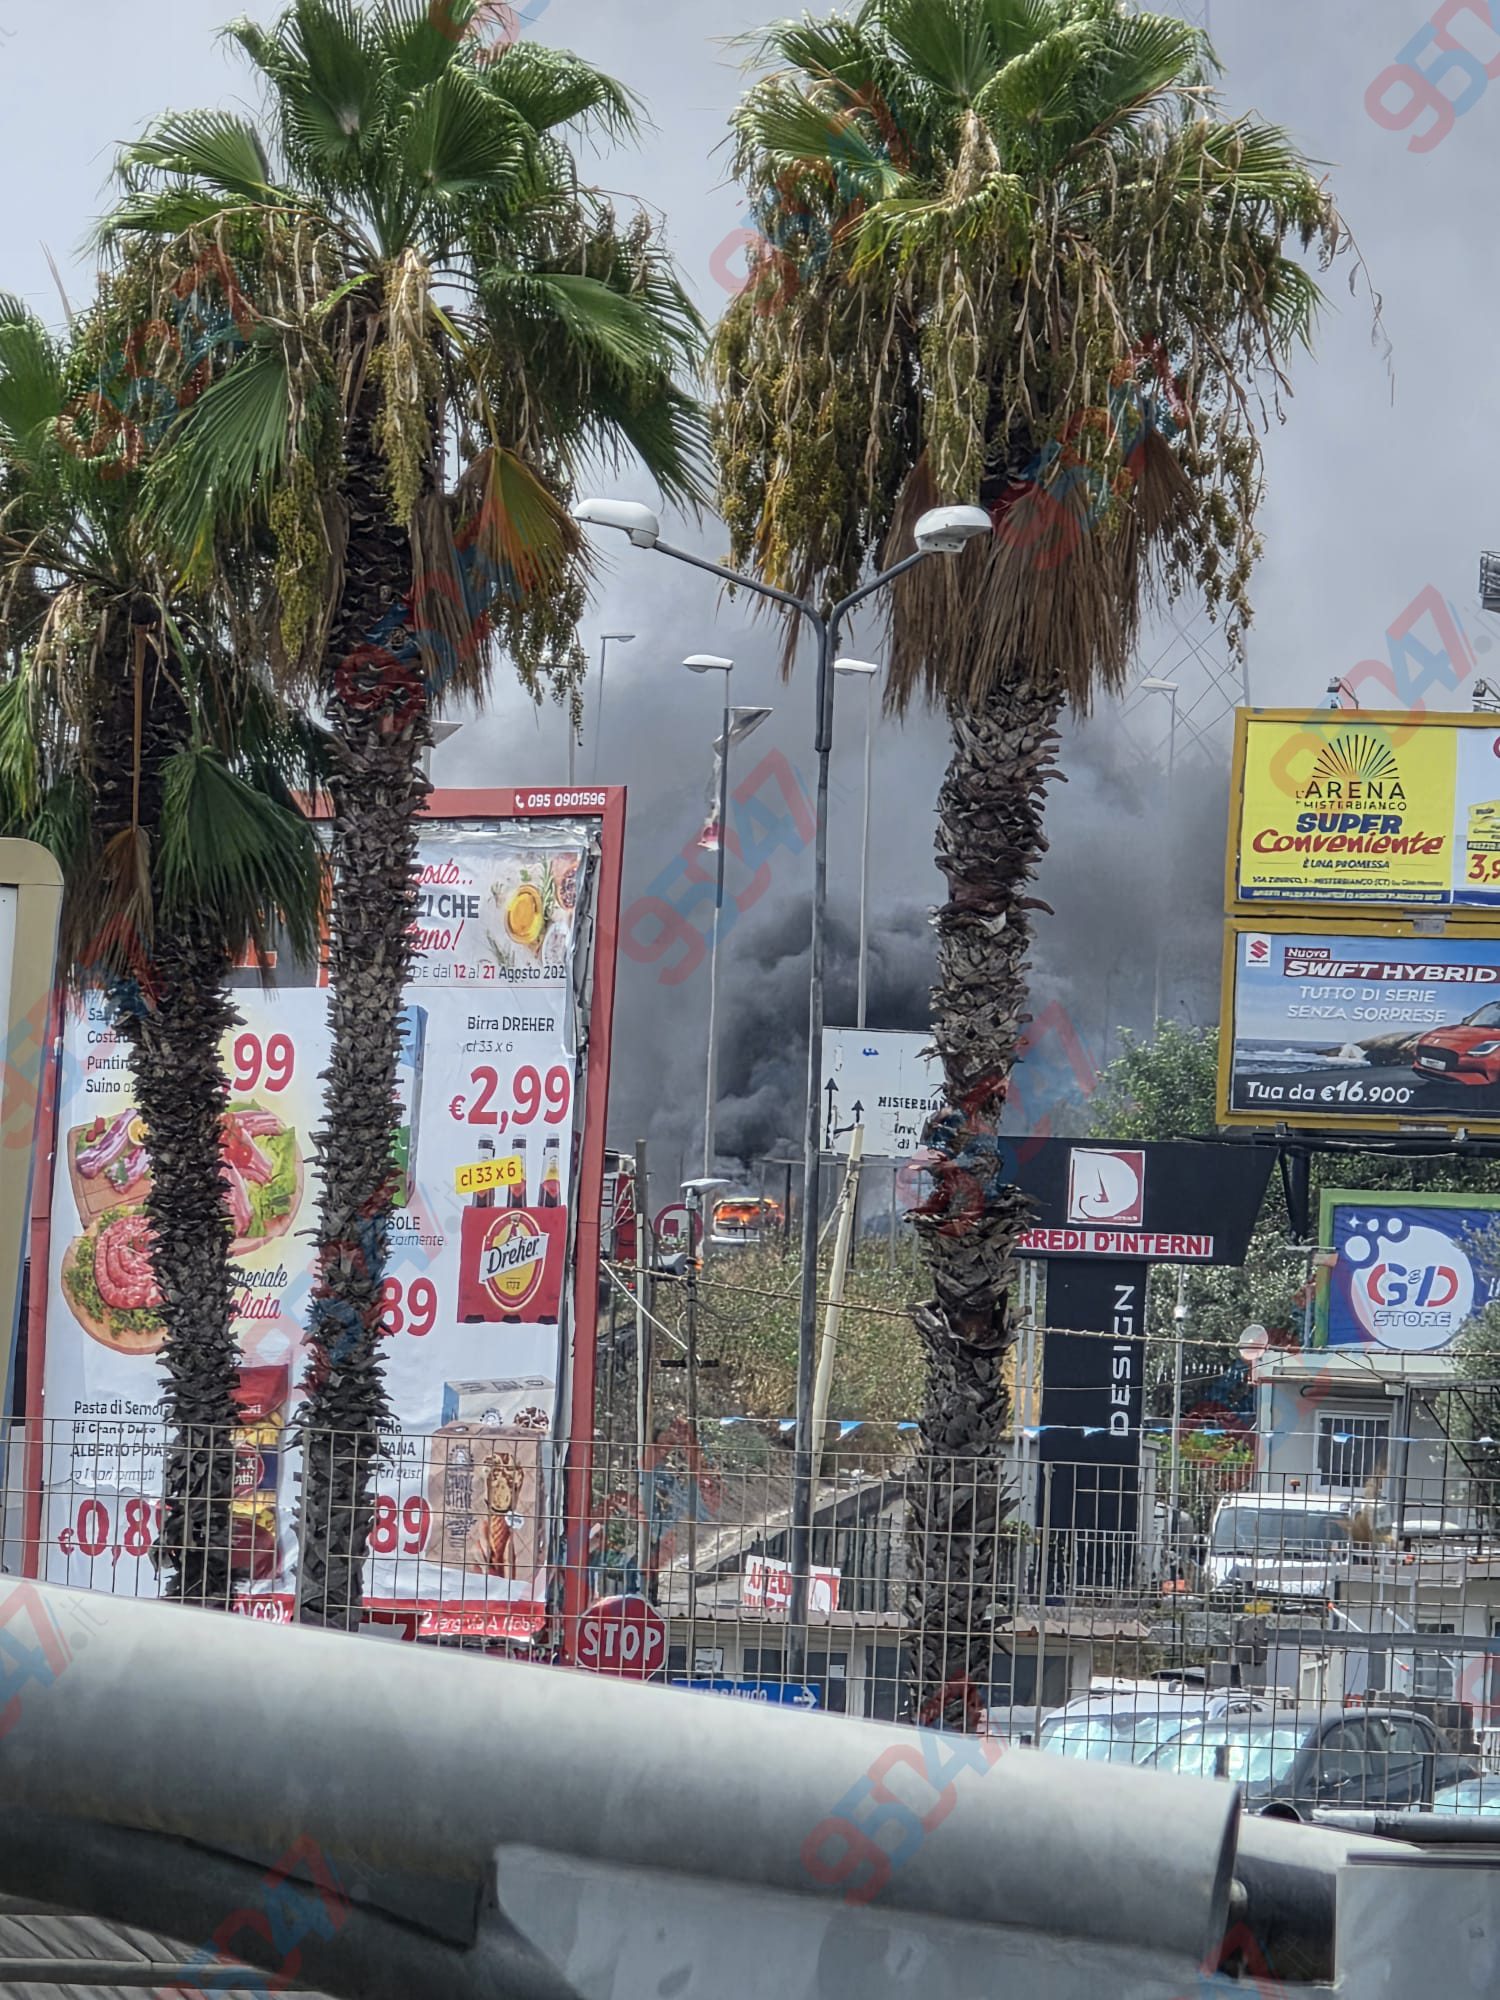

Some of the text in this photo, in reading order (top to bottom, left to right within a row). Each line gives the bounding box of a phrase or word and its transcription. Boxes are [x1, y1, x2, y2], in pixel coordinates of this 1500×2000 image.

[527, 793, 606, 808] 095 0901596
[1296, 812, 1403, 834] SUPER
[1252, 829, 1446, 855] Conveniente
[437, 894, 481, 919] CHE
[1287, 948, 1328, 958] Nuova
[433, 964, 451, 978] dal
[454, 964, 466, 978] 12
[468, 964, 480, 979] al
[482, 965, 496, 979] 21
[498, 965, 541, 984] Agosto
[1286, 960, 1498, 982] SWIFT HYBRID
[1299, 985, 1437, 1003] TUTTO DI SERIE
[1287, 1004, 1447, 1023] SENZA SORPRESE
[467, 1015, 555, 1032] Birra DREHER
[506, 1041, 513, 1053] 6
[87, 1054, 129, 1071] Puntin
[85, 1076, 121, 1093] Suino
[1247, 1081, 1285, 1099] Tua
[1288, 1083, 1316, 1100] da
[448, 1065, 571, 1134] €2,99
[460, 1161, 516, 1186] cl 33 x 6
[1093, 1232, 1212, 1256] D'INTERNI
[486, 1236, 540, 1274] Dreher
[230, 1263, 288, 1288] peciale
[1373, 1310, 1452, 1328] STORE
[1110, 1284, 1135, 1437] DESIGN
[74, 1400, 107, 1414] Pasta
[110, 1400, 122, 1414] di
[71, 1443, 130, 1458] ALBERTO
[582, 1621, 662, 1660] STOP
